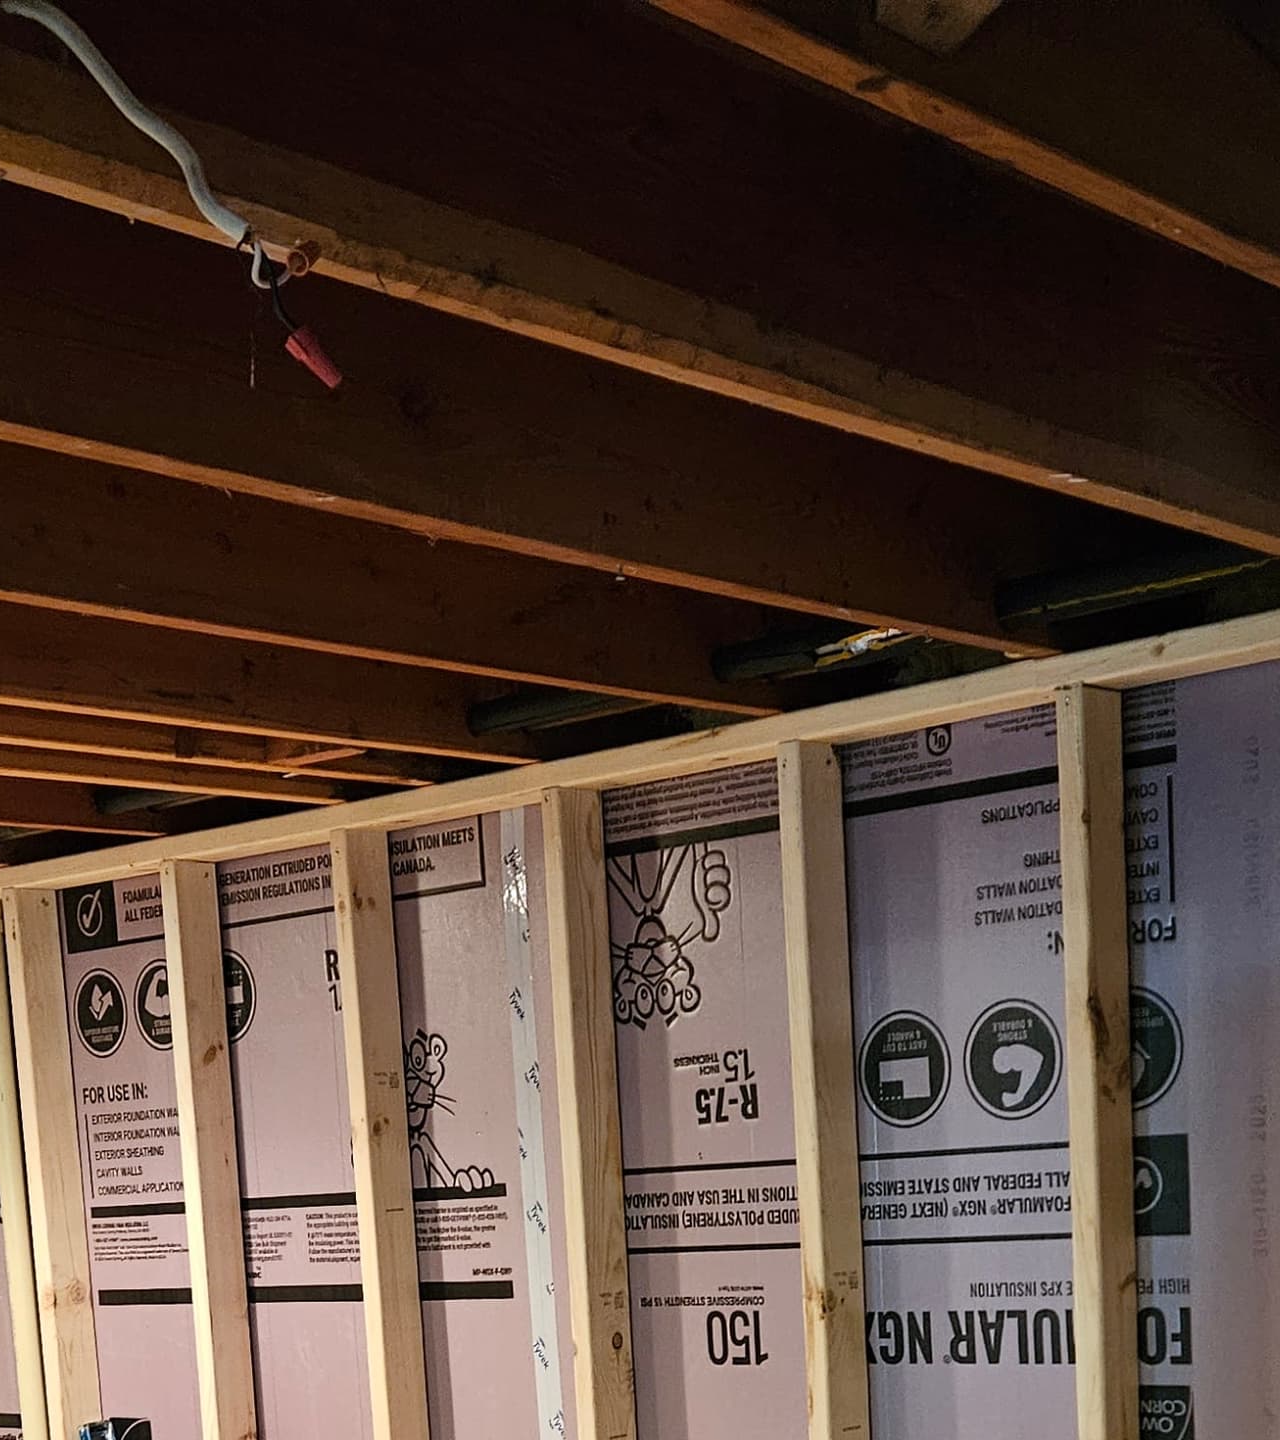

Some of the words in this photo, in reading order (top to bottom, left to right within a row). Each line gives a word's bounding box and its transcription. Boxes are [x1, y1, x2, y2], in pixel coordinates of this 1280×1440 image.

[1133, 916, 1176, 943] FOR
[723, 1048, 756, 1083] 1.5
[82, 1085, 104, 1105] FOR
[107, 1083, 130, 1102] USE
[132, 1081, 148, 1100] IN:
[694, 1082, 759, 1126] R-7.5
[706, 1310, 769, 1366] 150
[948, 1307, 1192, 1366] FOULAR
